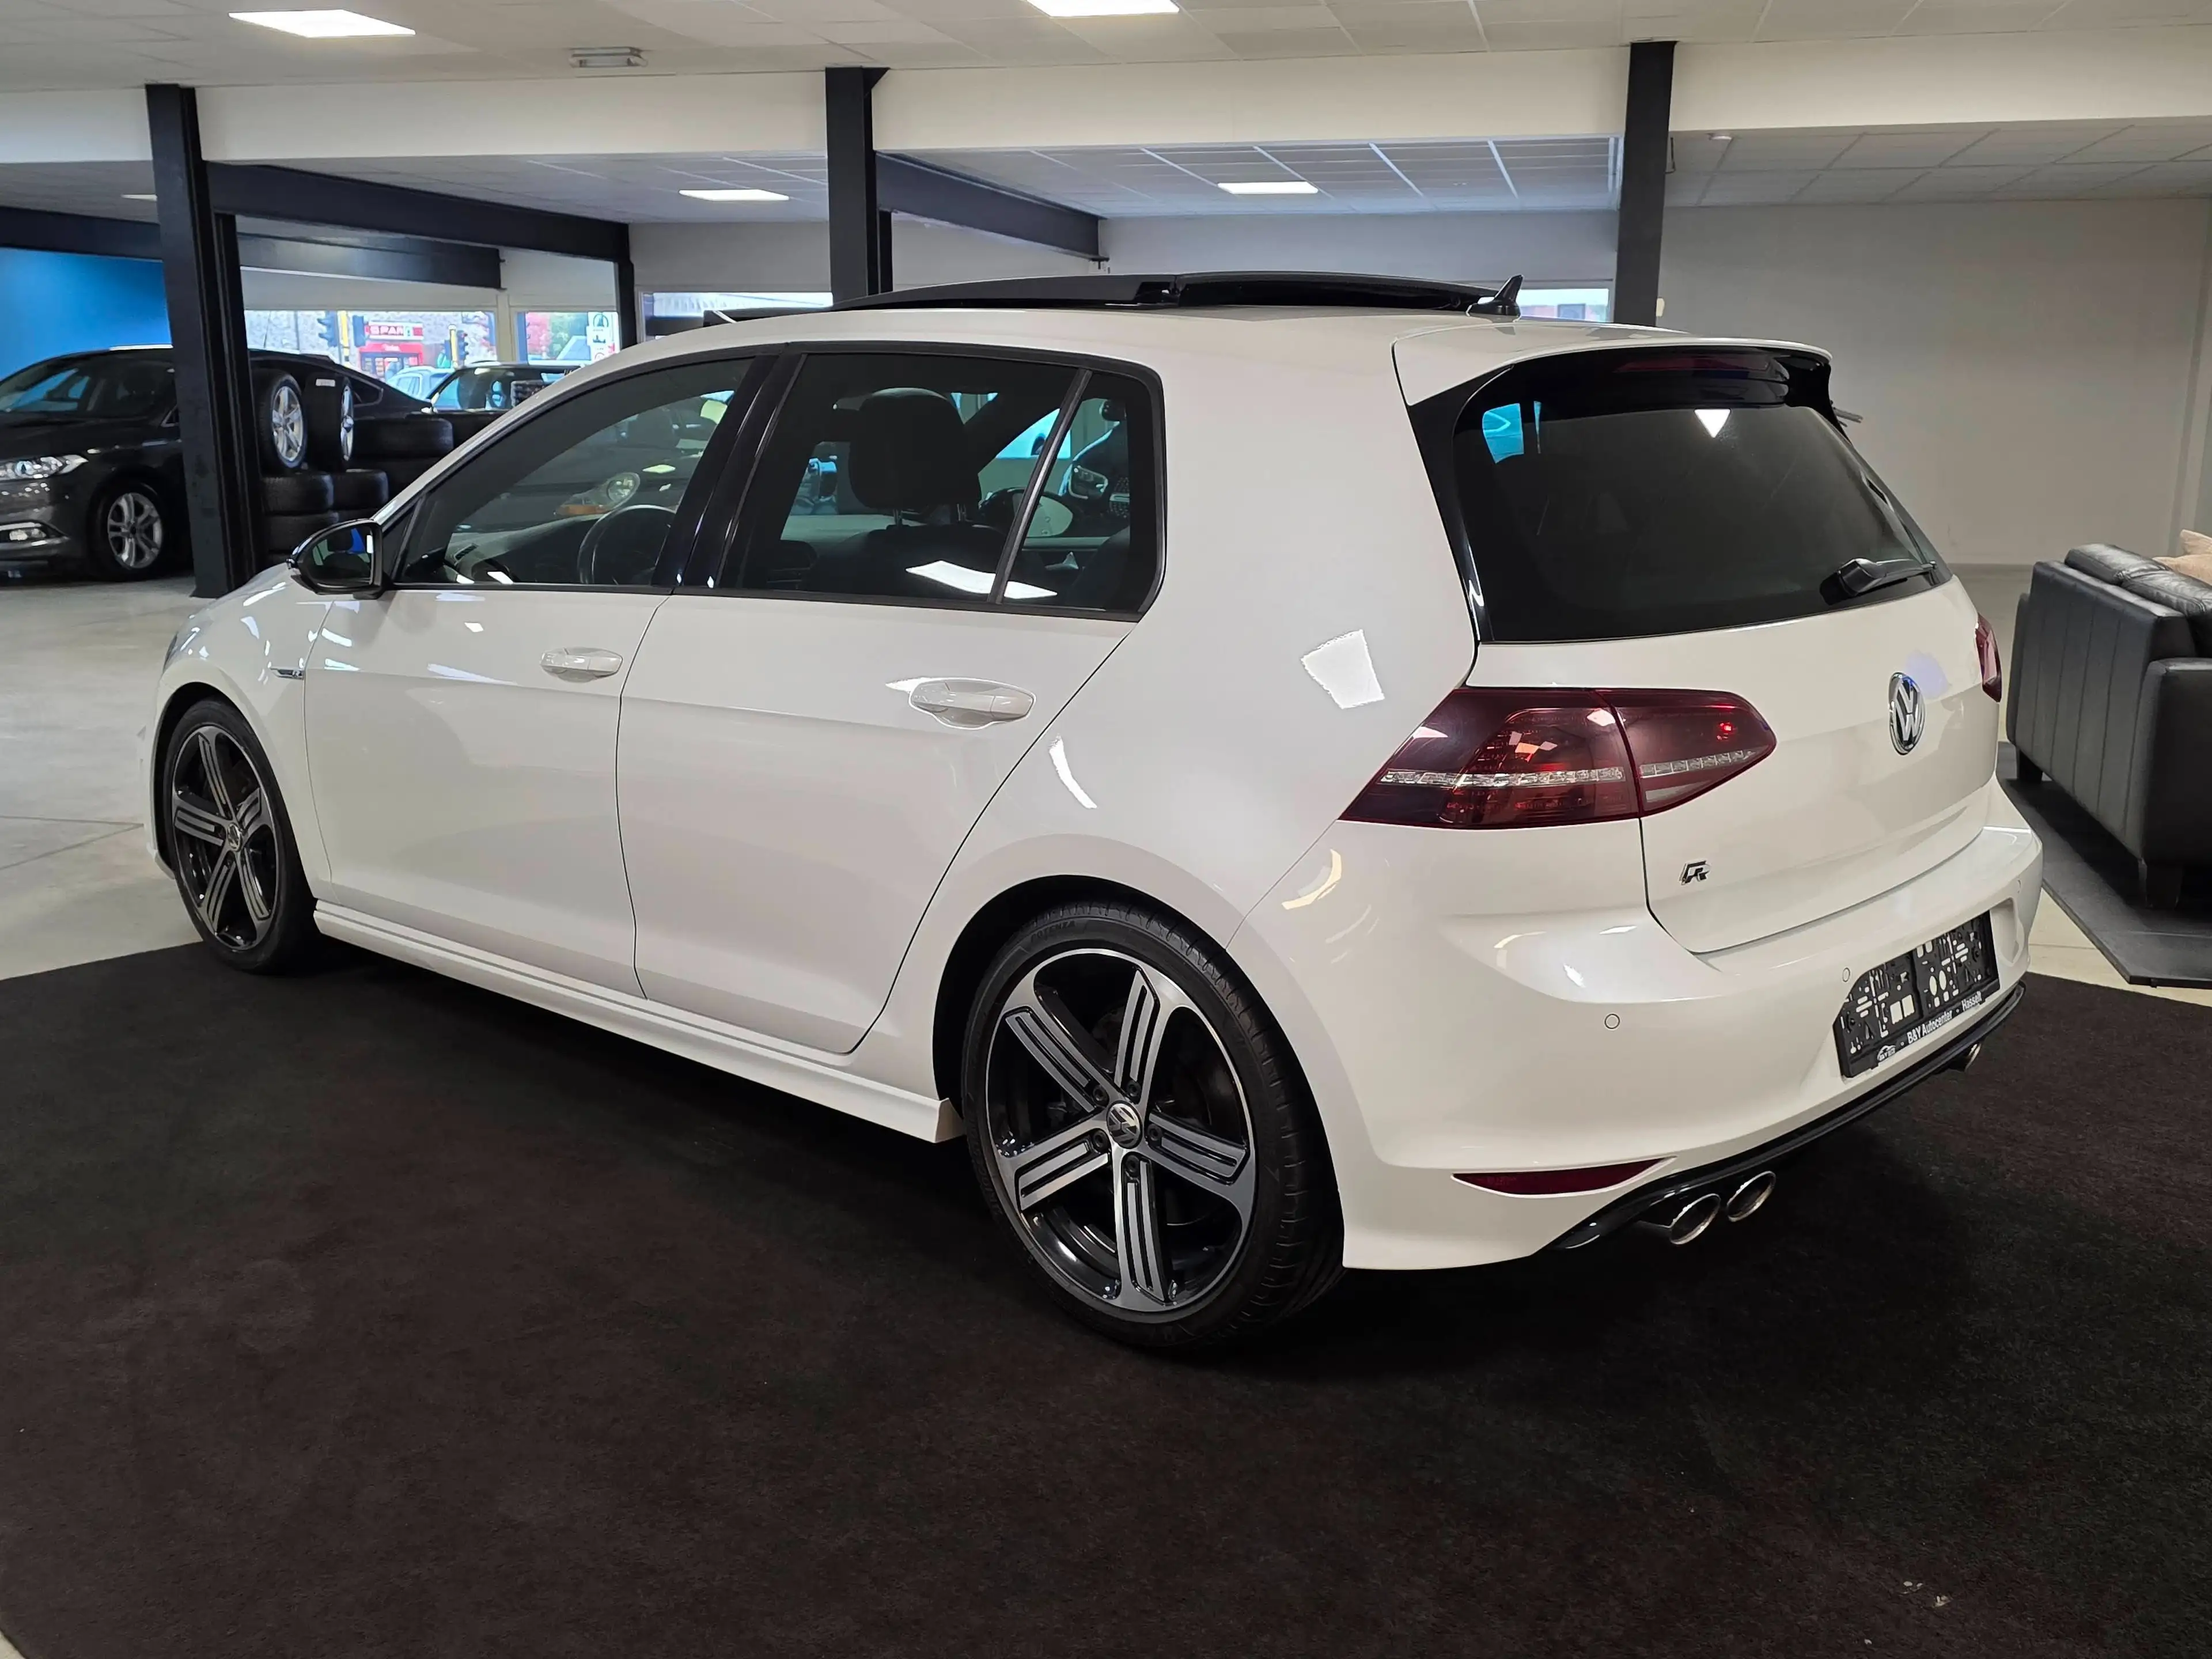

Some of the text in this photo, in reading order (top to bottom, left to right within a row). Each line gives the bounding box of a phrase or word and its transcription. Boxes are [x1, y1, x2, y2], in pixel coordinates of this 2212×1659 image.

[370, 324, 404, 336] SPAR
[1679, 859, 1711, 886] R
[1906, 990, 1983, 1044] B&Y Autocenter Hasselt
